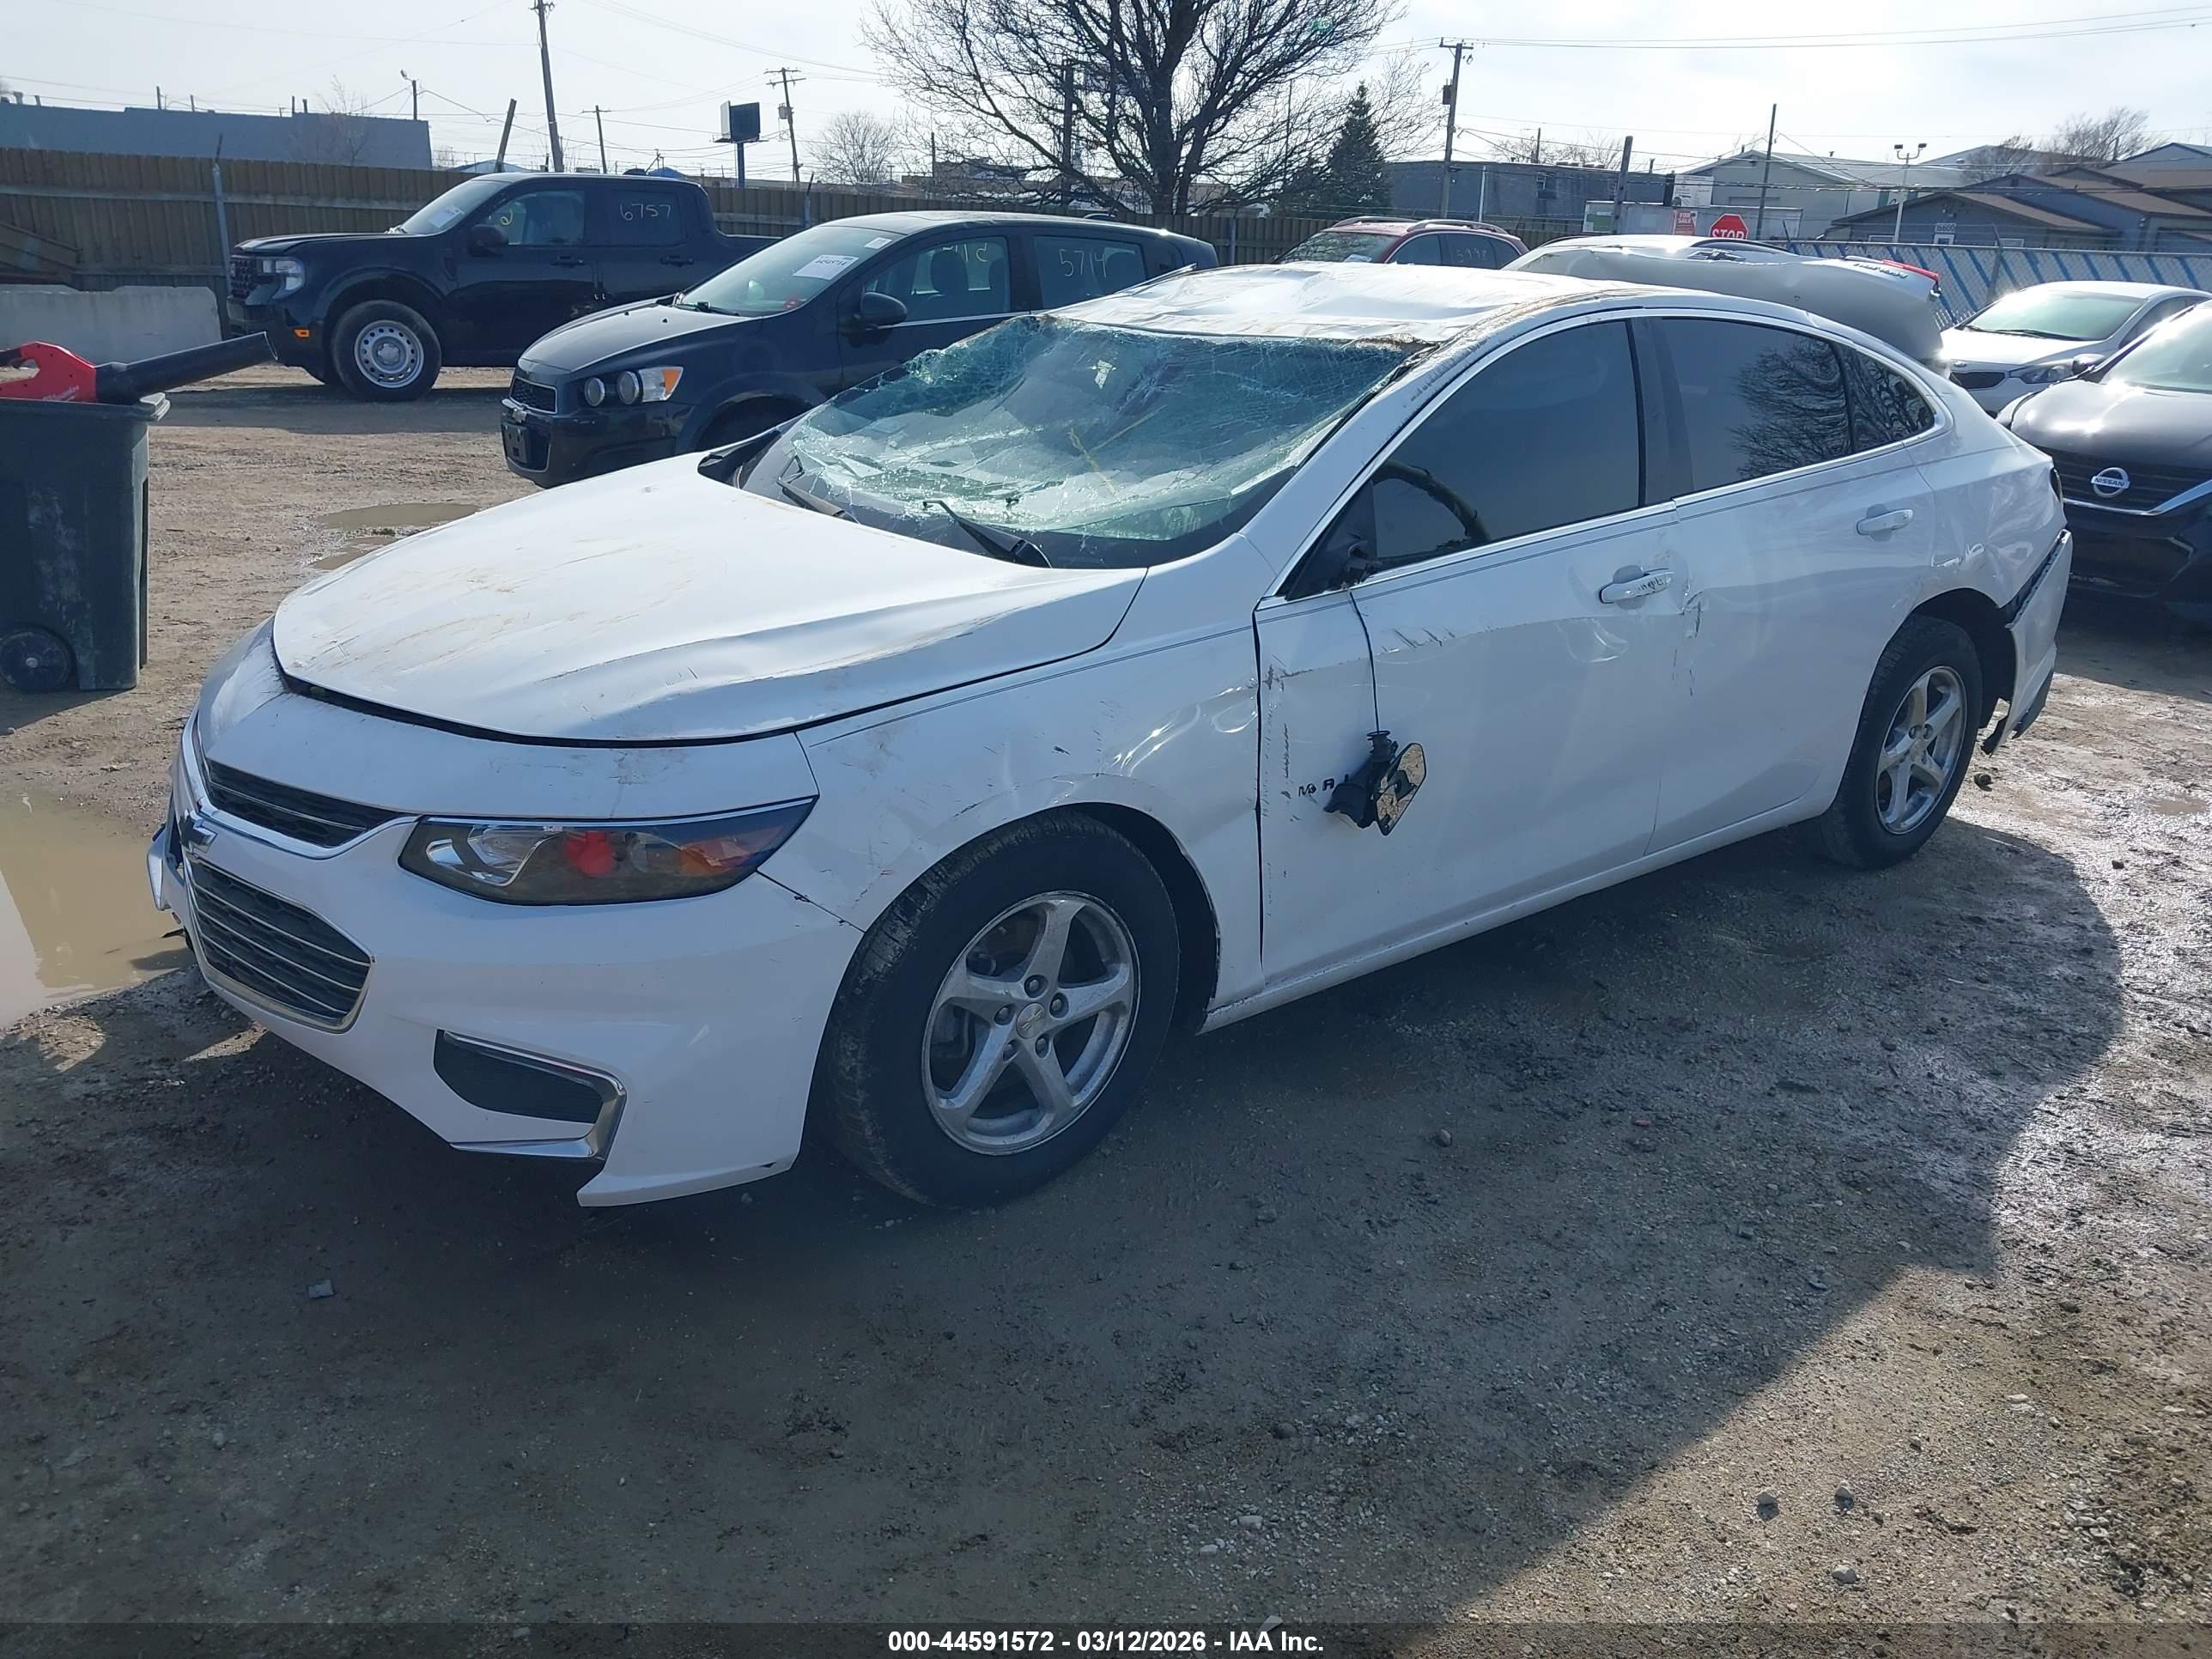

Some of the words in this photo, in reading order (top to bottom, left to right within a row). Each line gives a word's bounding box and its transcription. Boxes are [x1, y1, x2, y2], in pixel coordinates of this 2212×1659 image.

[619, 203, 671, 221] 6757
[1711, 228, 1745, 239] STOP
[1059, 247, 1107, 278] 5714
[2095, 477, 2124, 487] NISSAN
